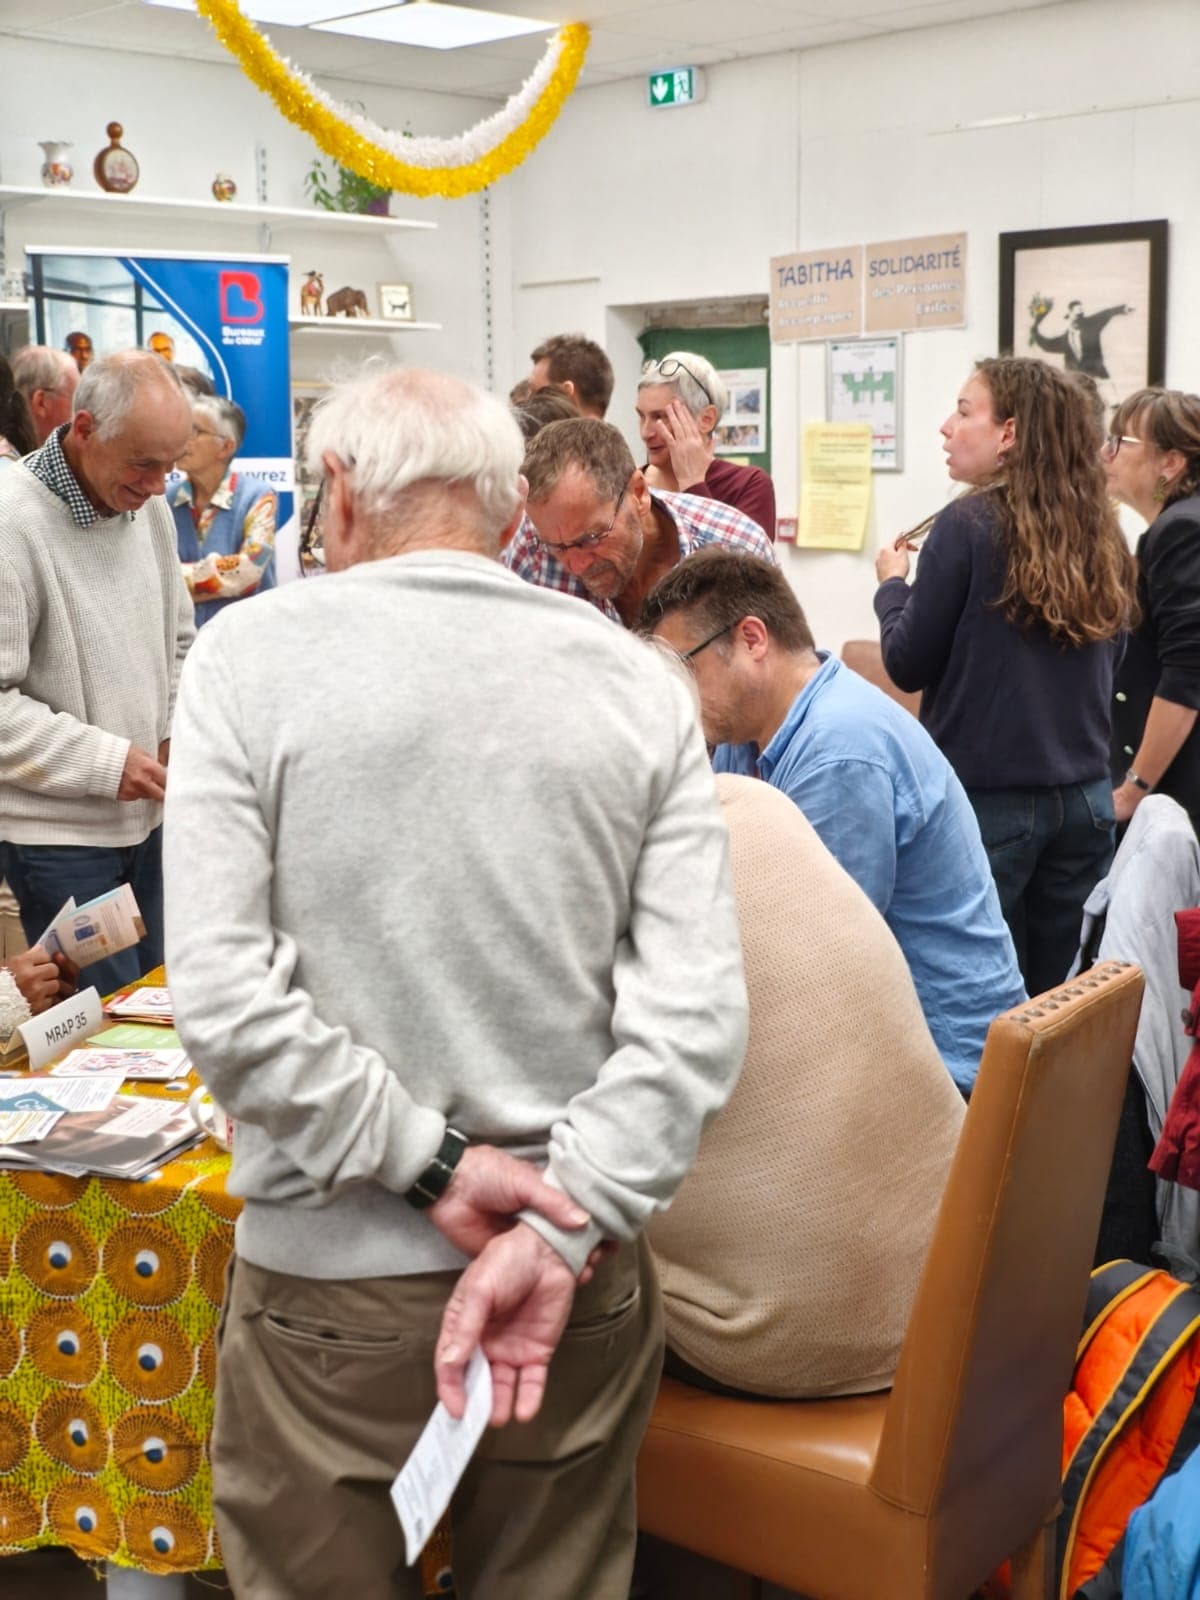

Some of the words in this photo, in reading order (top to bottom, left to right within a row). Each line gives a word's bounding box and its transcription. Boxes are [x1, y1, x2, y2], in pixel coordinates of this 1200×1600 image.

[777, 258, 854, 288] TABITHA
[868, 244, 961, 278] SOLIDARITÉ
[45, 1018, 74, 1047] MRAP
[74, 1011, 88, 1030] 35
